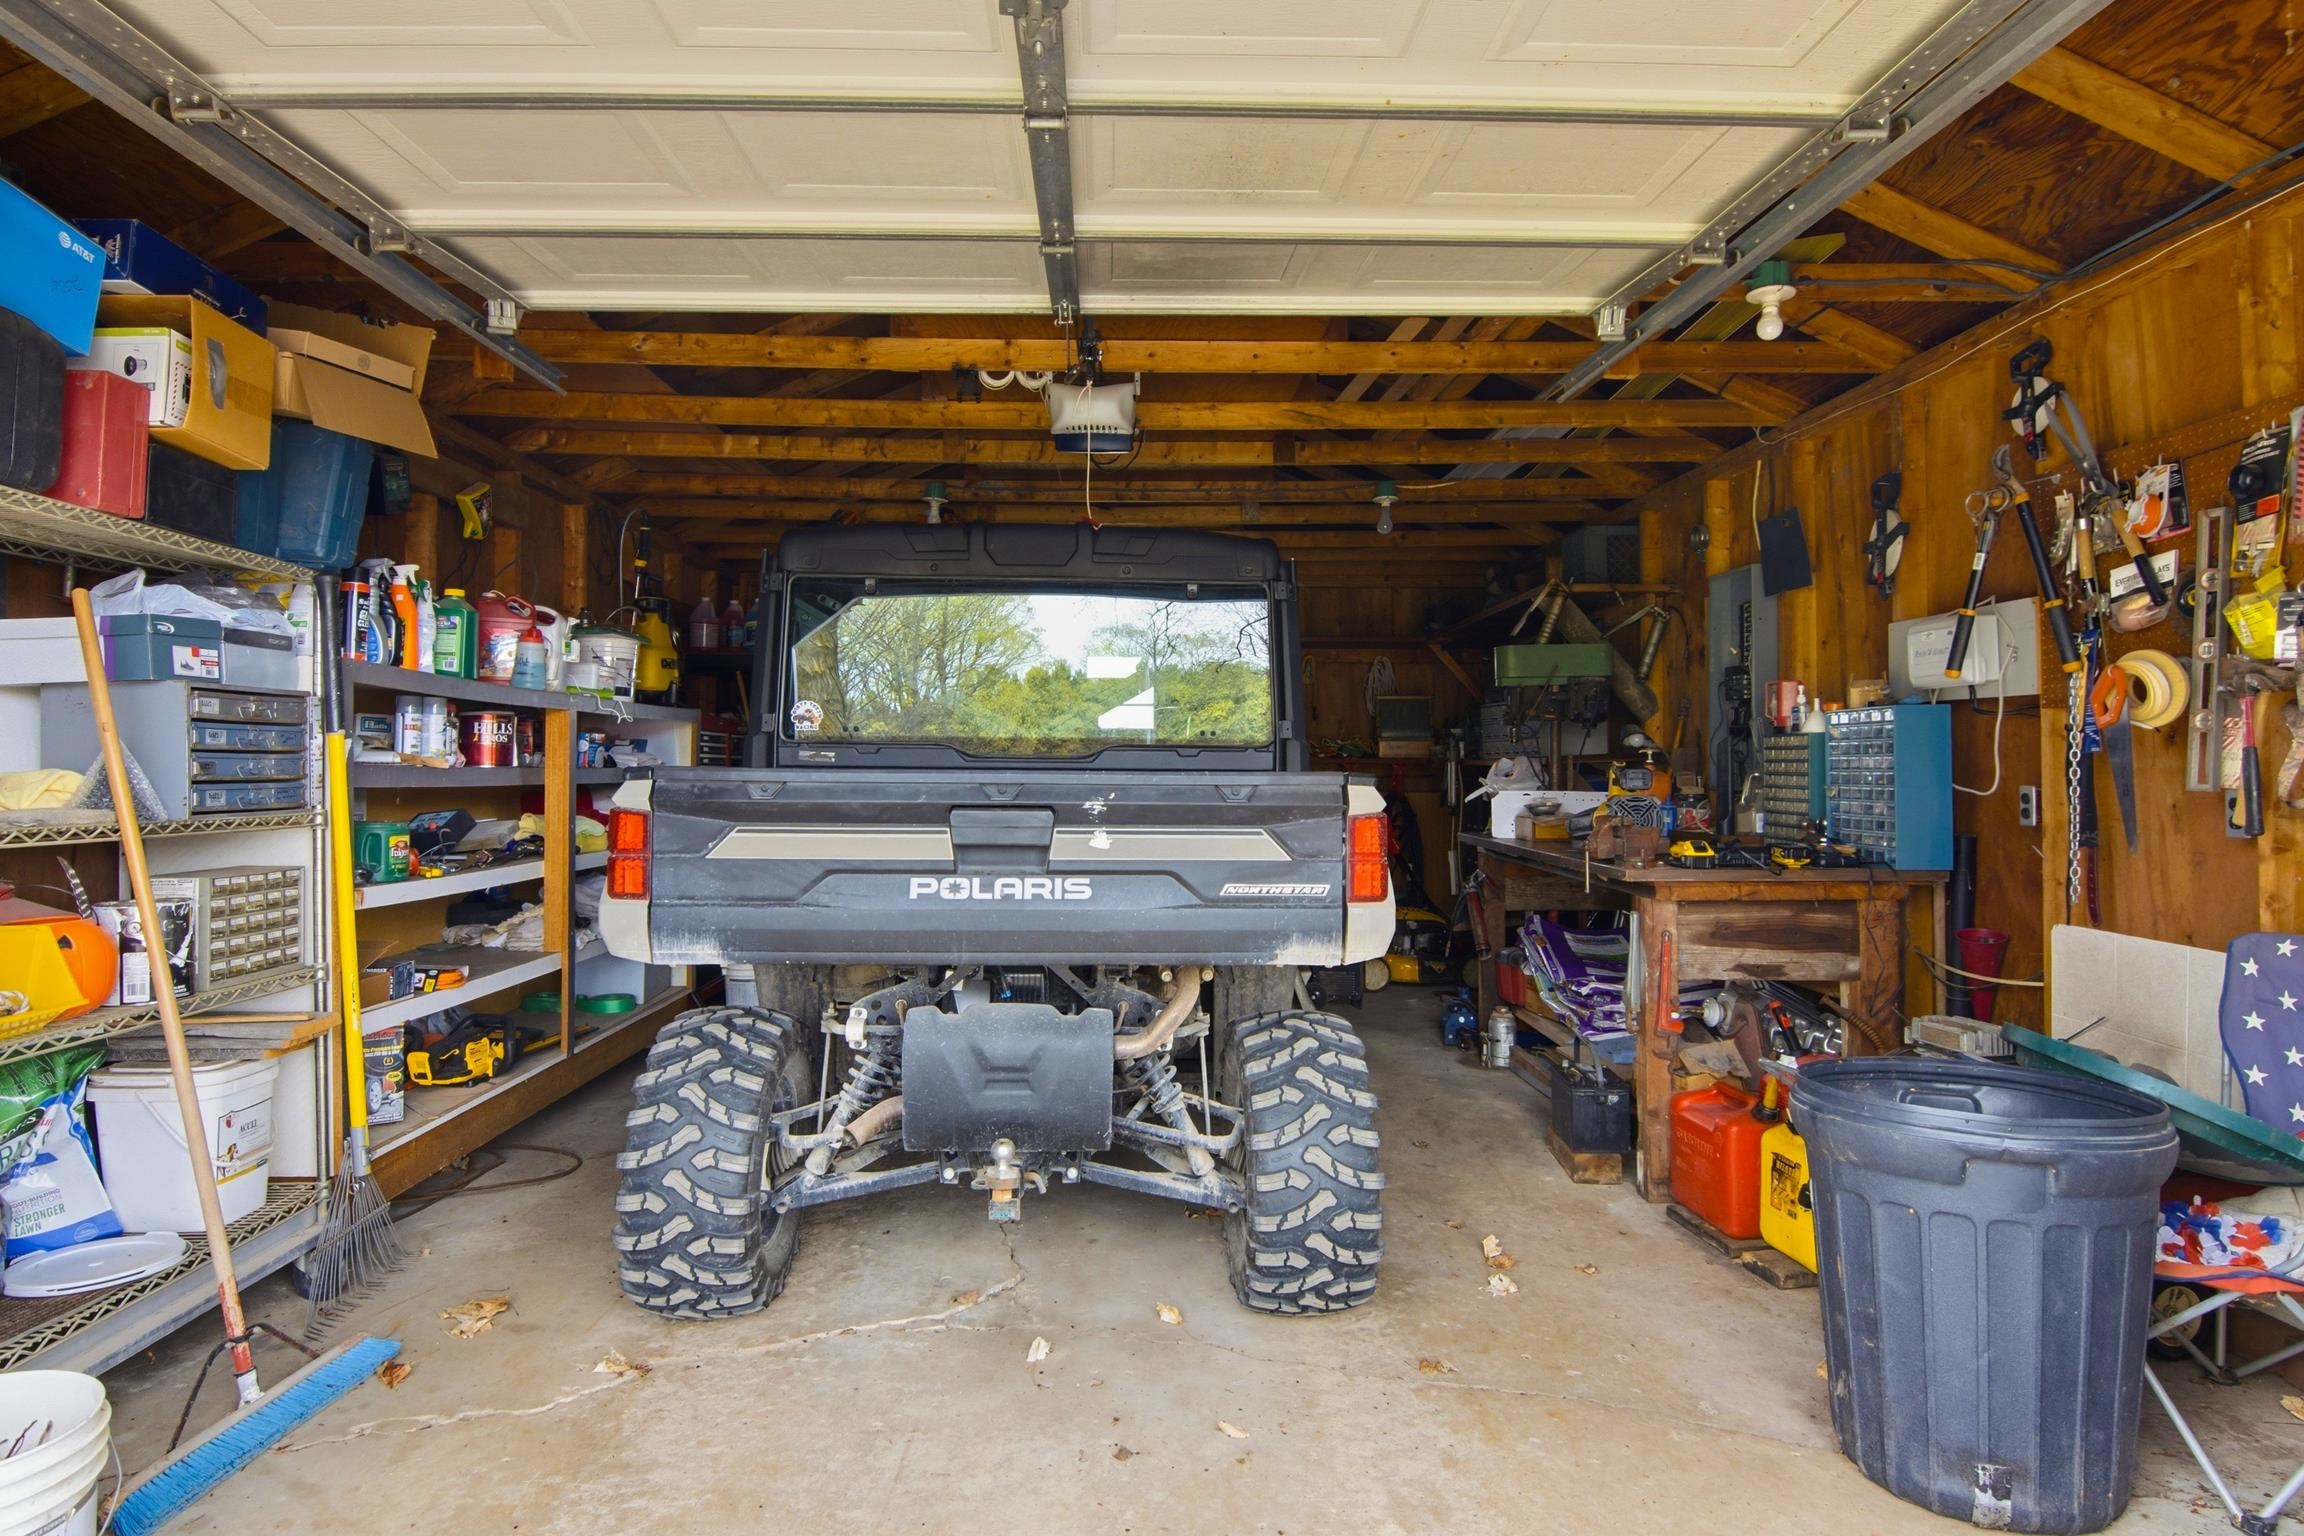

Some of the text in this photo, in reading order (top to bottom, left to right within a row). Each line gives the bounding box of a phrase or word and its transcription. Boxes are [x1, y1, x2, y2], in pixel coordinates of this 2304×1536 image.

[72, 243, 95, 263] AT&T
[473, 721, 513, 735] HILLS
[909, 877, 1092, 900] POLARIS
[1223, 885, 1328, 895] NORTHSTAR
[13, 1203, 66, 1228] STRONGER
[15, 1221, 42, 1237] LAWN
